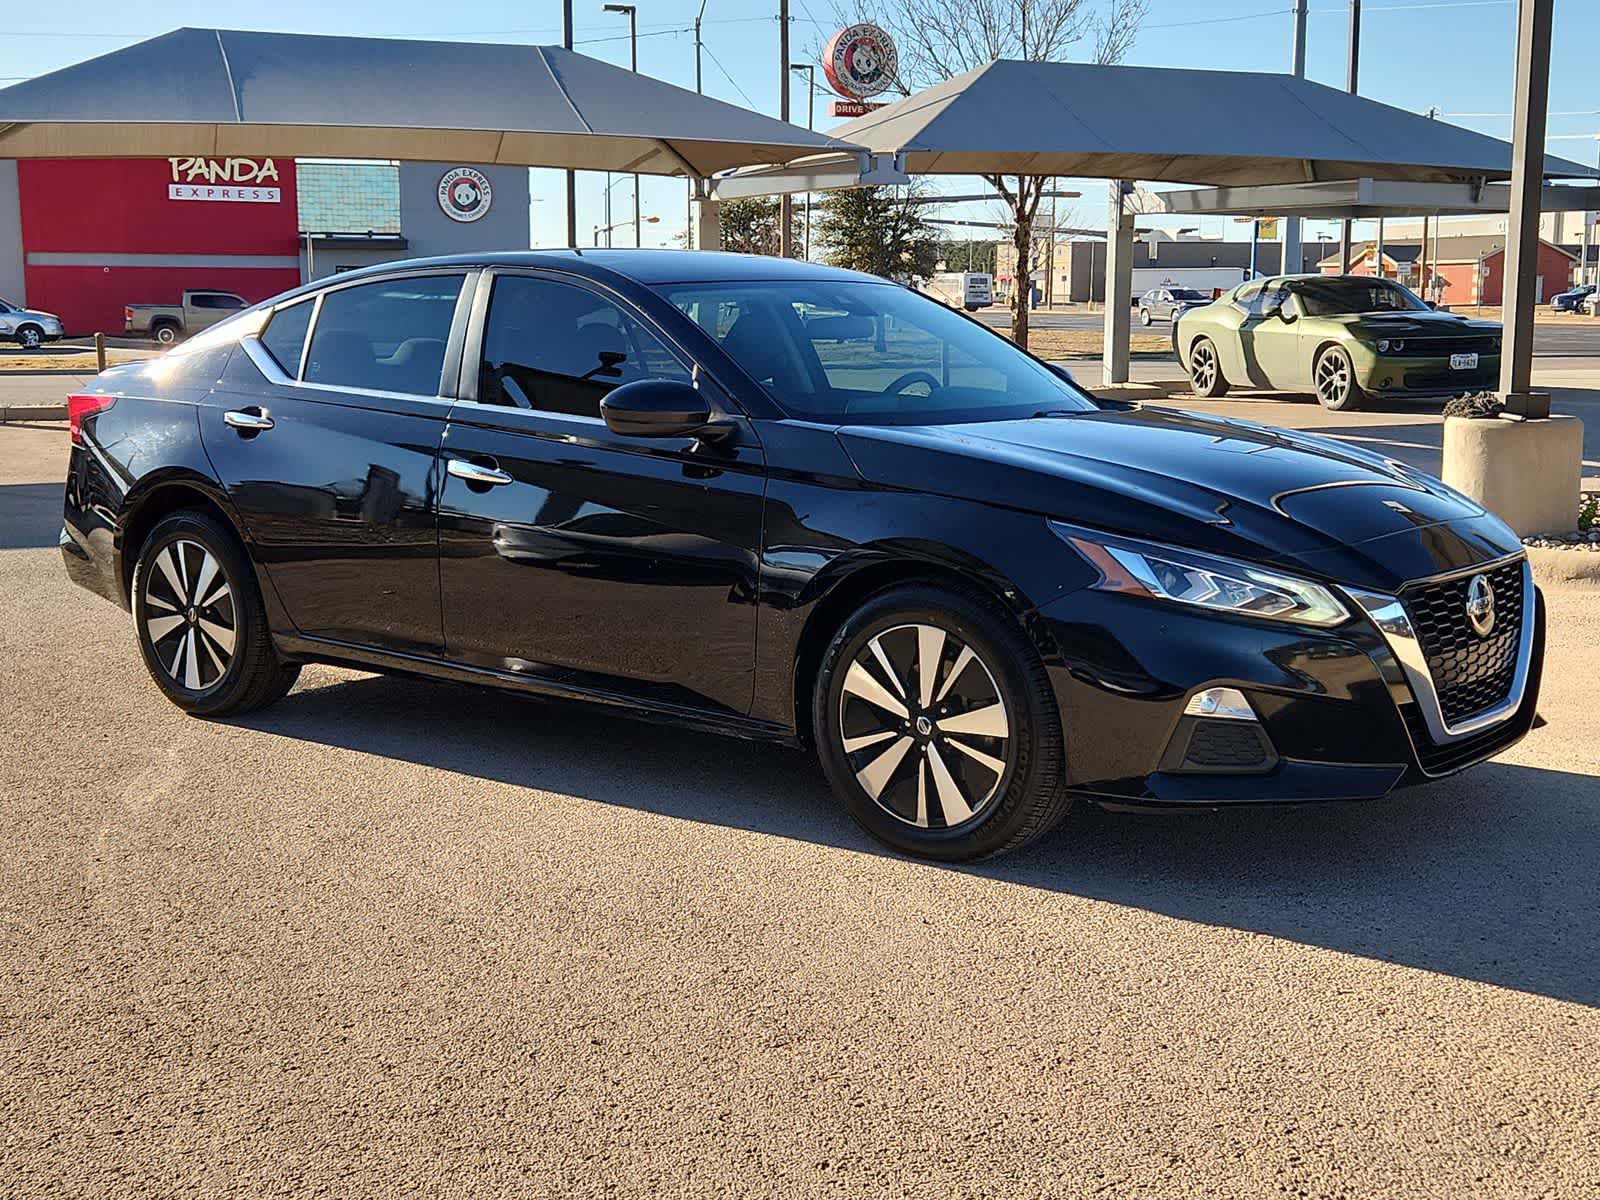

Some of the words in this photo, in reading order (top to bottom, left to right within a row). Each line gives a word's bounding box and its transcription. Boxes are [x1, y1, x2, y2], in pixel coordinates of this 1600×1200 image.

[835, 29, 860, 61] PANDA
[835, 105, 864, 113] DRIVE
[168, 157, 279, 184] PANDA
[440, 171, 460, 196] PANDA
[462, 168, 490, 197] EXPRESS
[175, 187, 275, 200] EXPRESS
